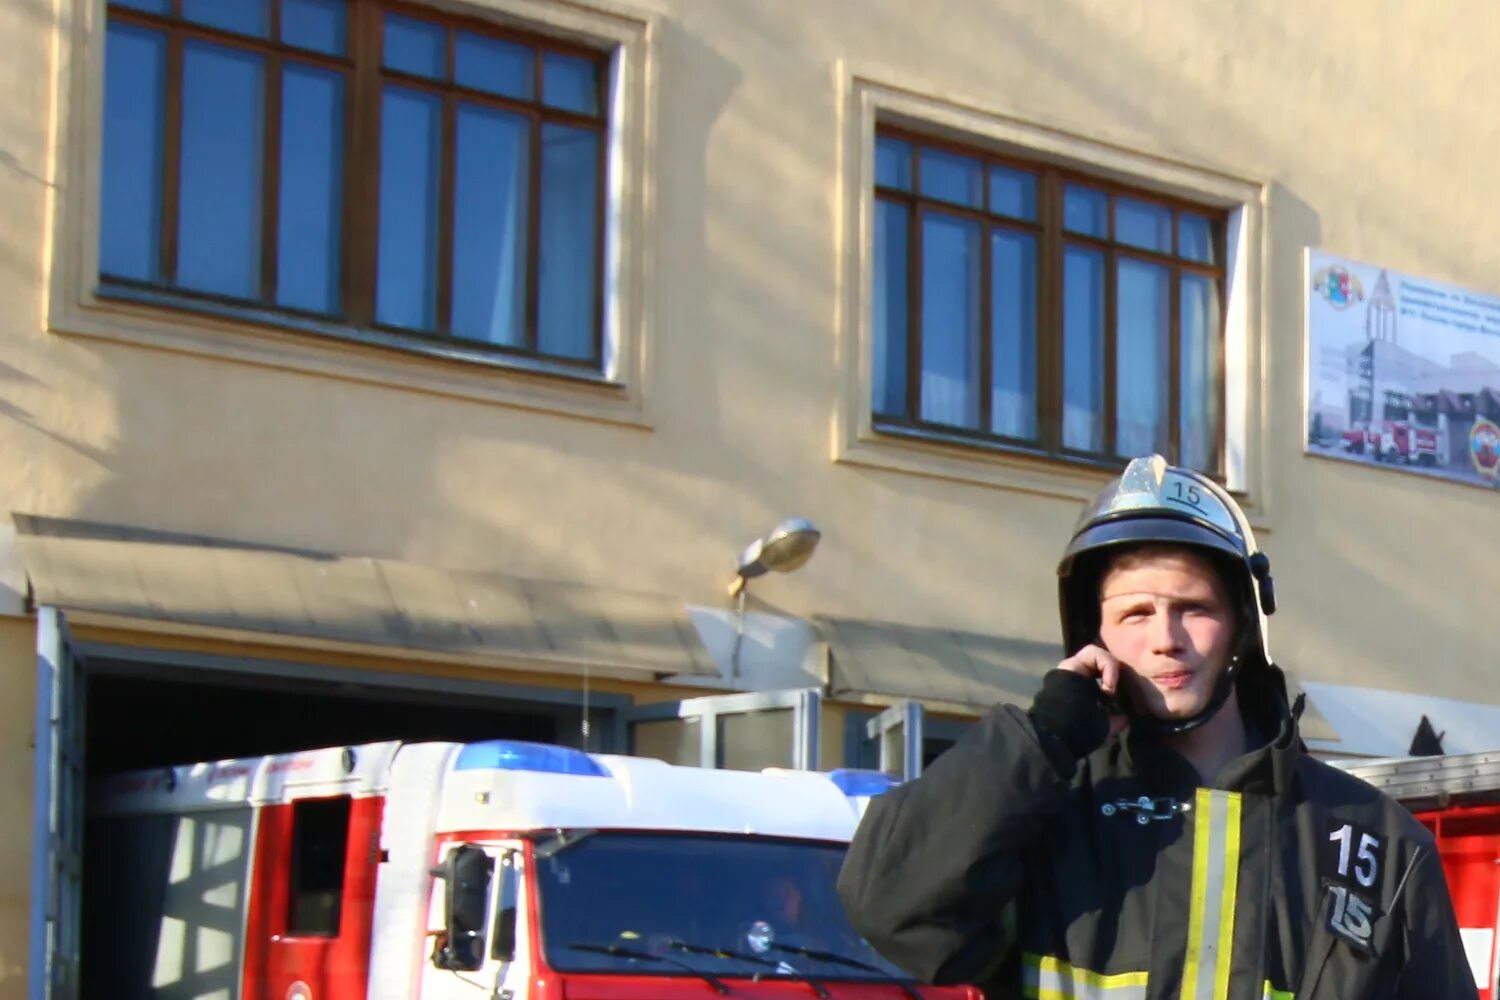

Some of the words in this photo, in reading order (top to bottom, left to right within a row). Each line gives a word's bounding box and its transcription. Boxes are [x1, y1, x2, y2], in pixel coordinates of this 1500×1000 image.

[1173, 481, 1200, 505] 15
[1329, 824, 1379, 887] 15
[1329, 886, 1372, 938] 15
